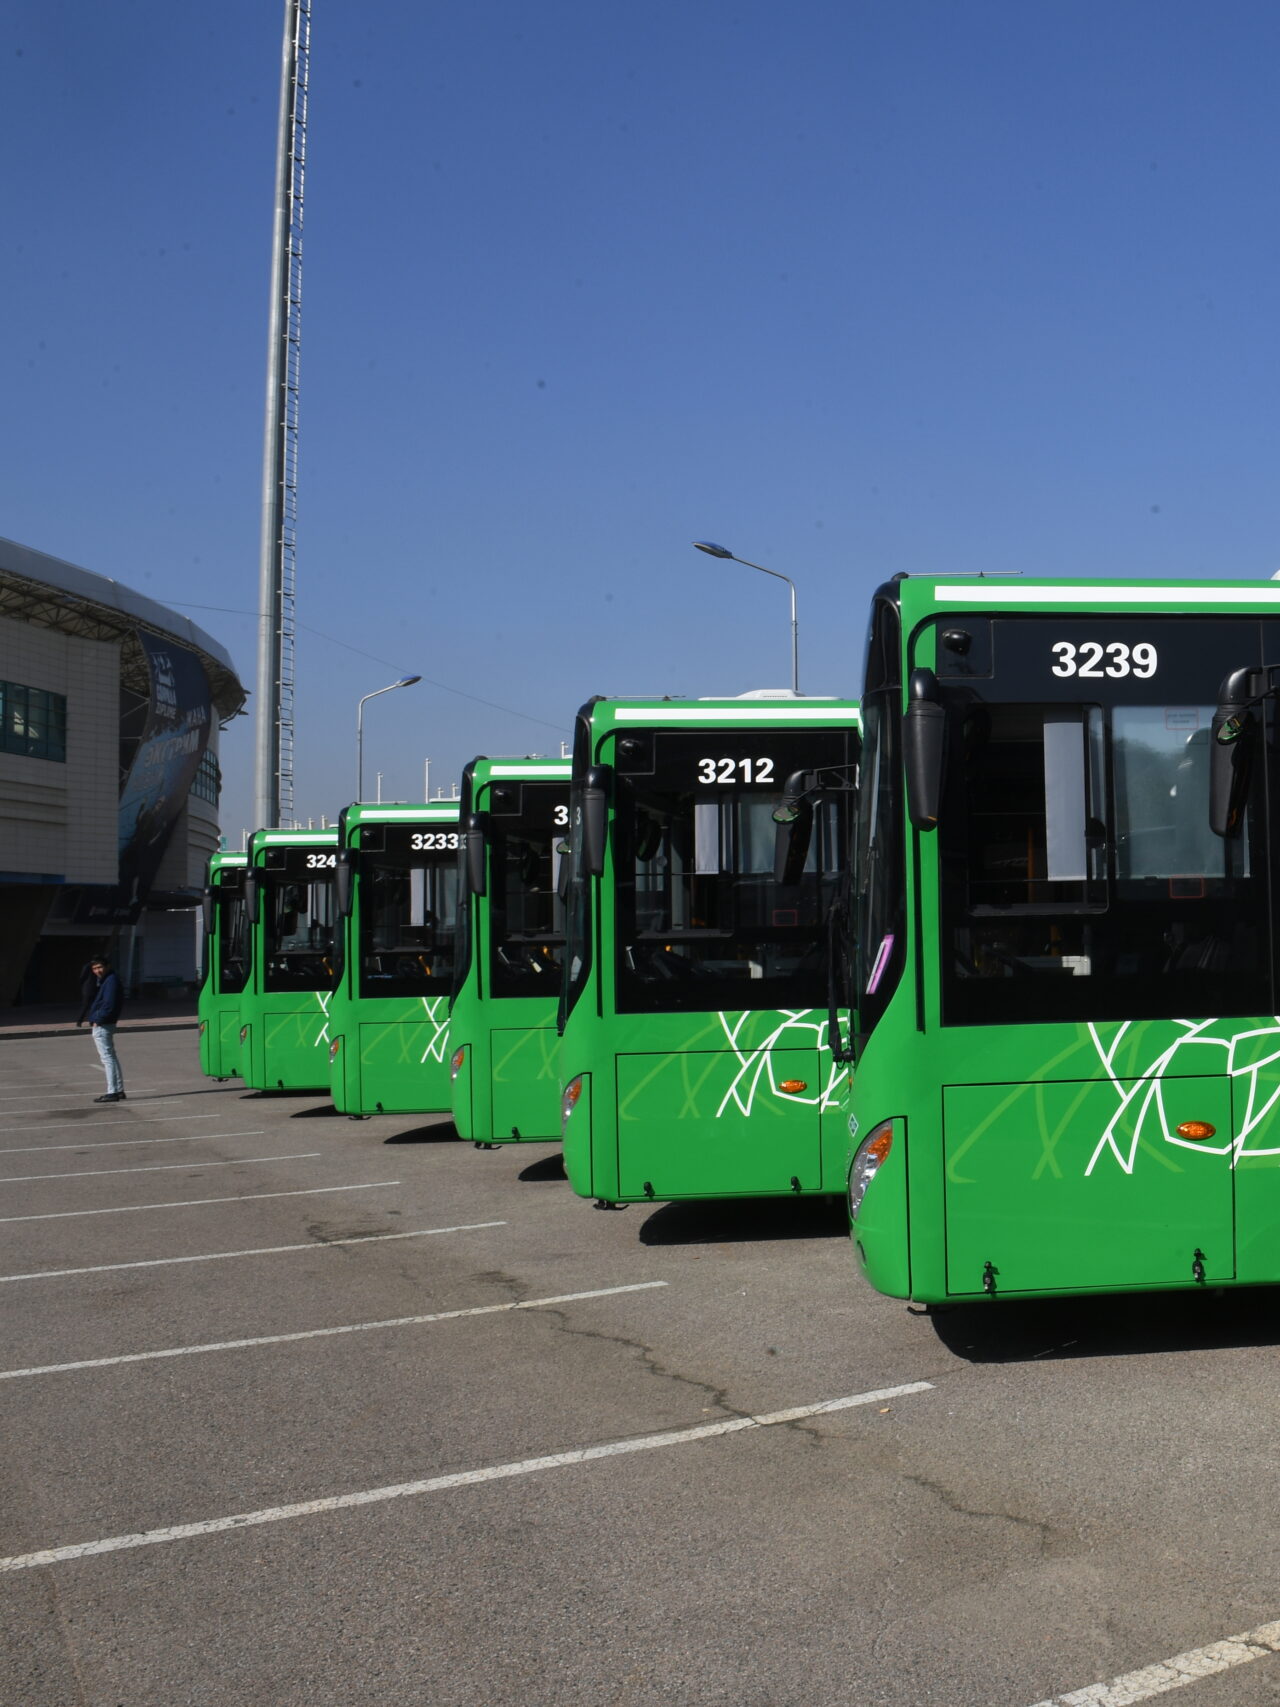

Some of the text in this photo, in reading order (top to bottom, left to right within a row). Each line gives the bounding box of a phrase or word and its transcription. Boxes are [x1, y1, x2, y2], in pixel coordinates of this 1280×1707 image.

[1051, 641, 1158, 679] 3239
[698, 758, 774, 785] 3212
[411, 833, 459, 850] 3233
